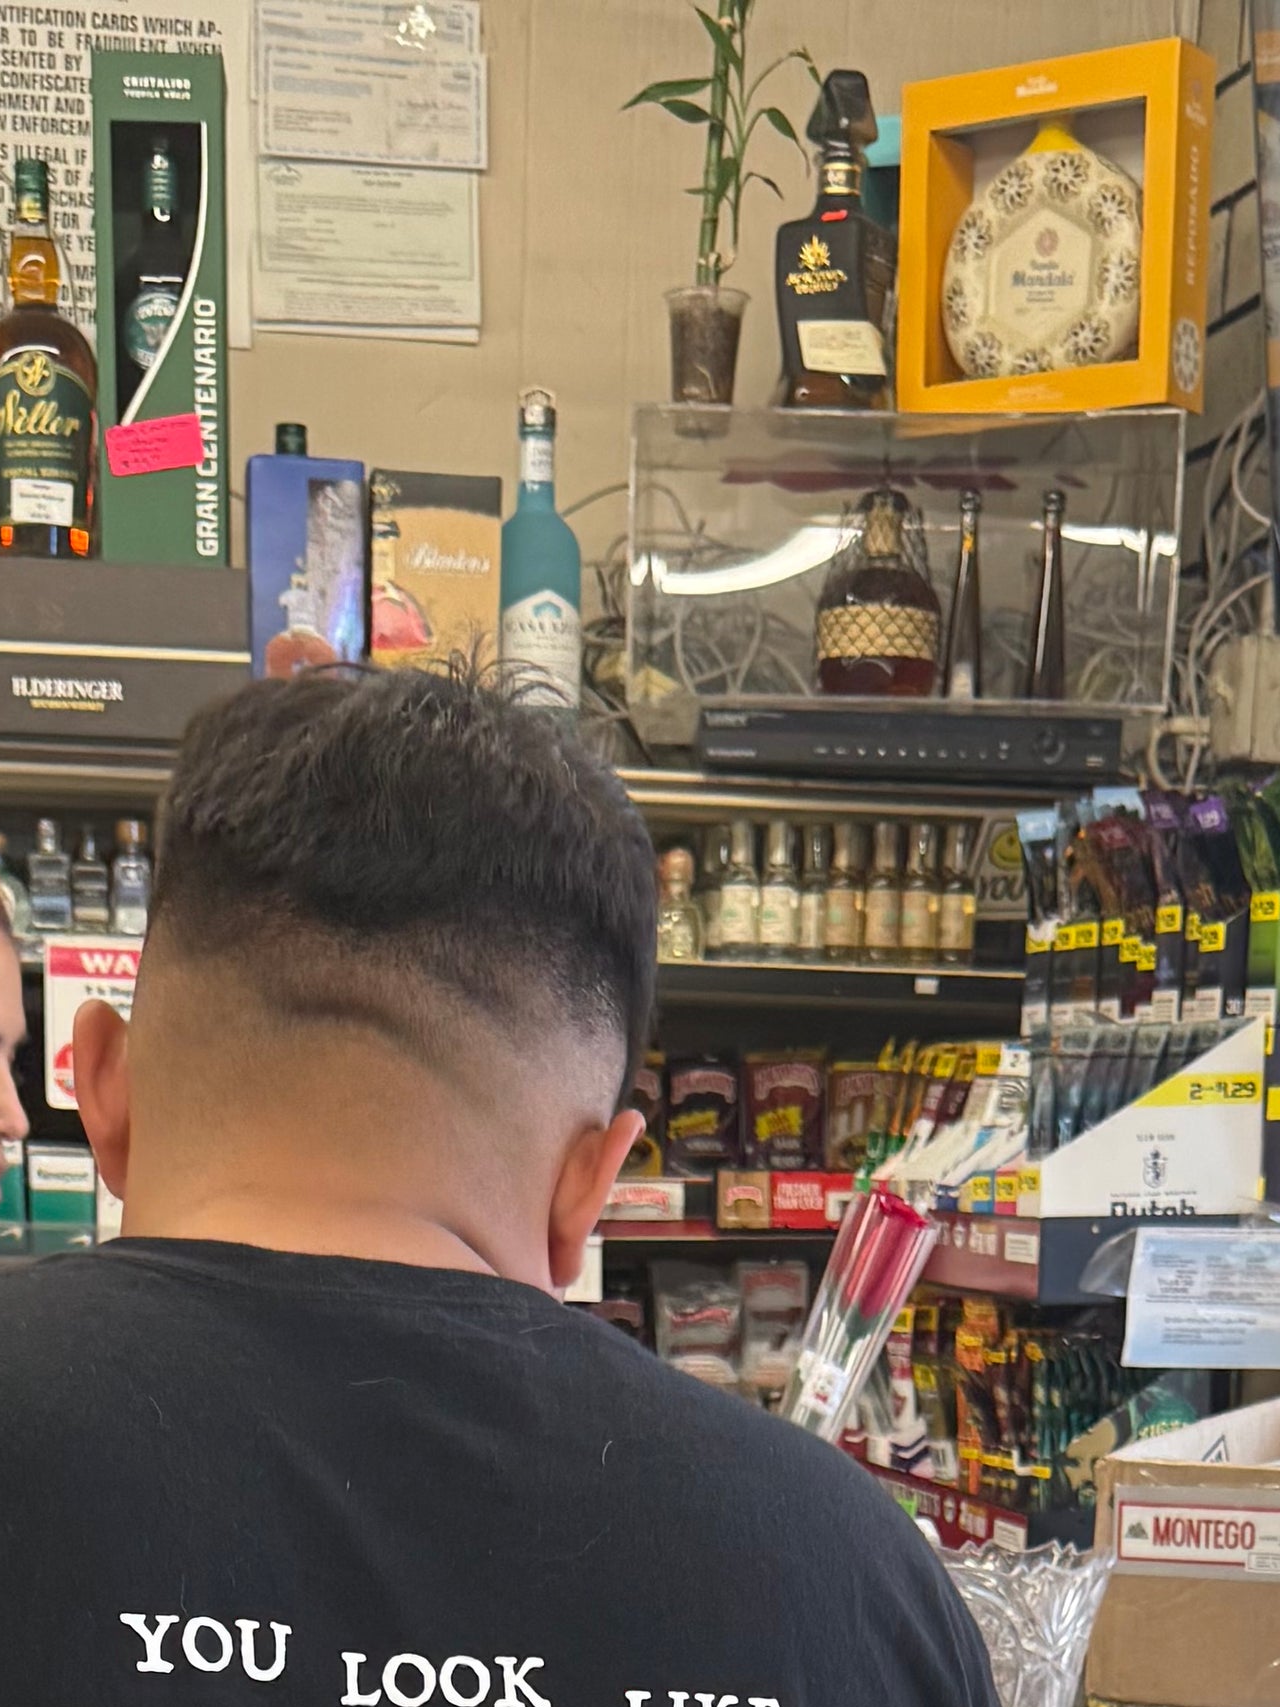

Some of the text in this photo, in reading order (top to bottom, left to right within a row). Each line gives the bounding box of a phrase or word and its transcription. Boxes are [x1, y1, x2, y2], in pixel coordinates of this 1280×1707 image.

[91, 11, 138, 32] CARDS
[143, 15, 193, 37] WHICH
[197, 20, 222, 39] AP-
[20, 29, 38, 47] TO
[47, 31, 65, 49] BE
[64, 54, 83, 72] BY
[0, 72, 90, 95] CONFISCATE
[54, 98, 85, 115] AND
[11, 115, 90, 136] ENFORCEM
[193, 298, 219, 556] GRAN CENTENARIO
[1152, 1515, 1256, 1551] MONTEGO
[119, 1612, 292, 1683] YOU
